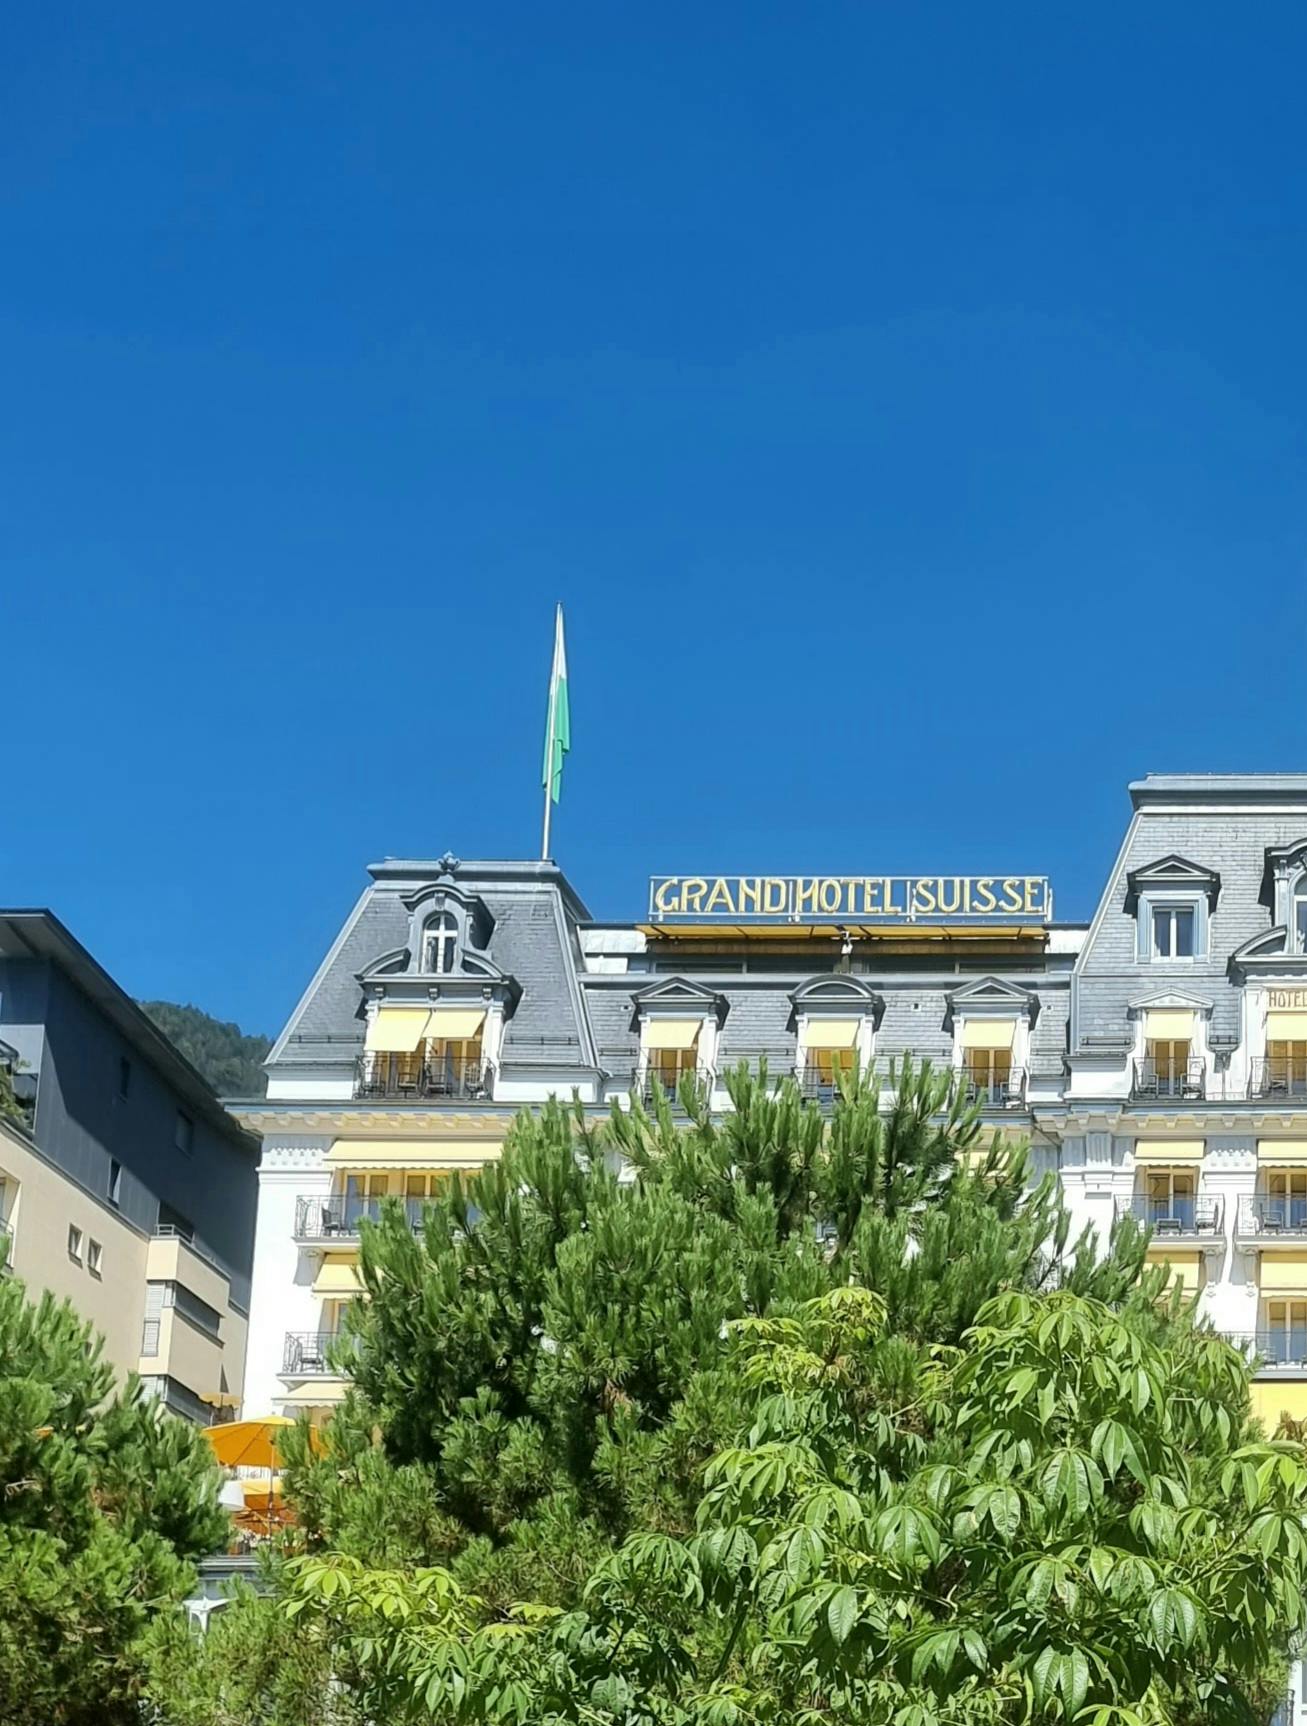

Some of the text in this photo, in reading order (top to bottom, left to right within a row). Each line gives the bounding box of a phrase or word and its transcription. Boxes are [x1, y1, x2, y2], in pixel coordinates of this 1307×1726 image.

[655, 878, 1044, 914] GRAND HOTEL SUISSE
